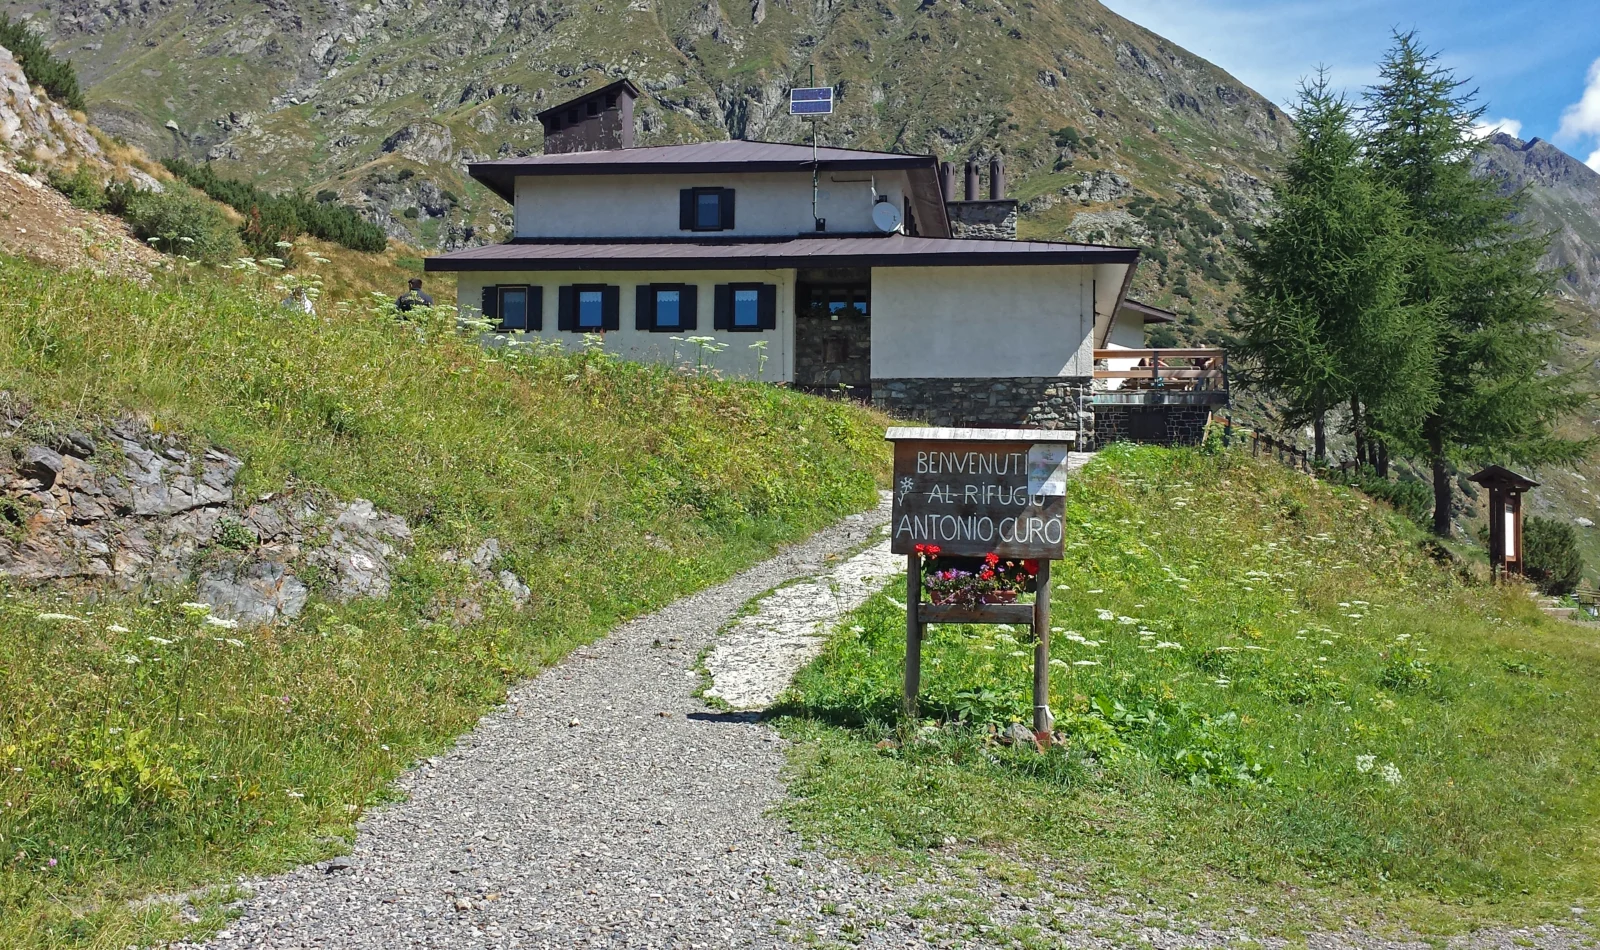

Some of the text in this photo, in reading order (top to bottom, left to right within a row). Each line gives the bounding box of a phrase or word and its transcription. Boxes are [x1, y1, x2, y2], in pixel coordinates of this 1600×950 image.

[917, 450, 1028, 475] BENVENUTI
[928, 484, 954, 504] AL
[896, 512, 993, 541] ANTONIO
